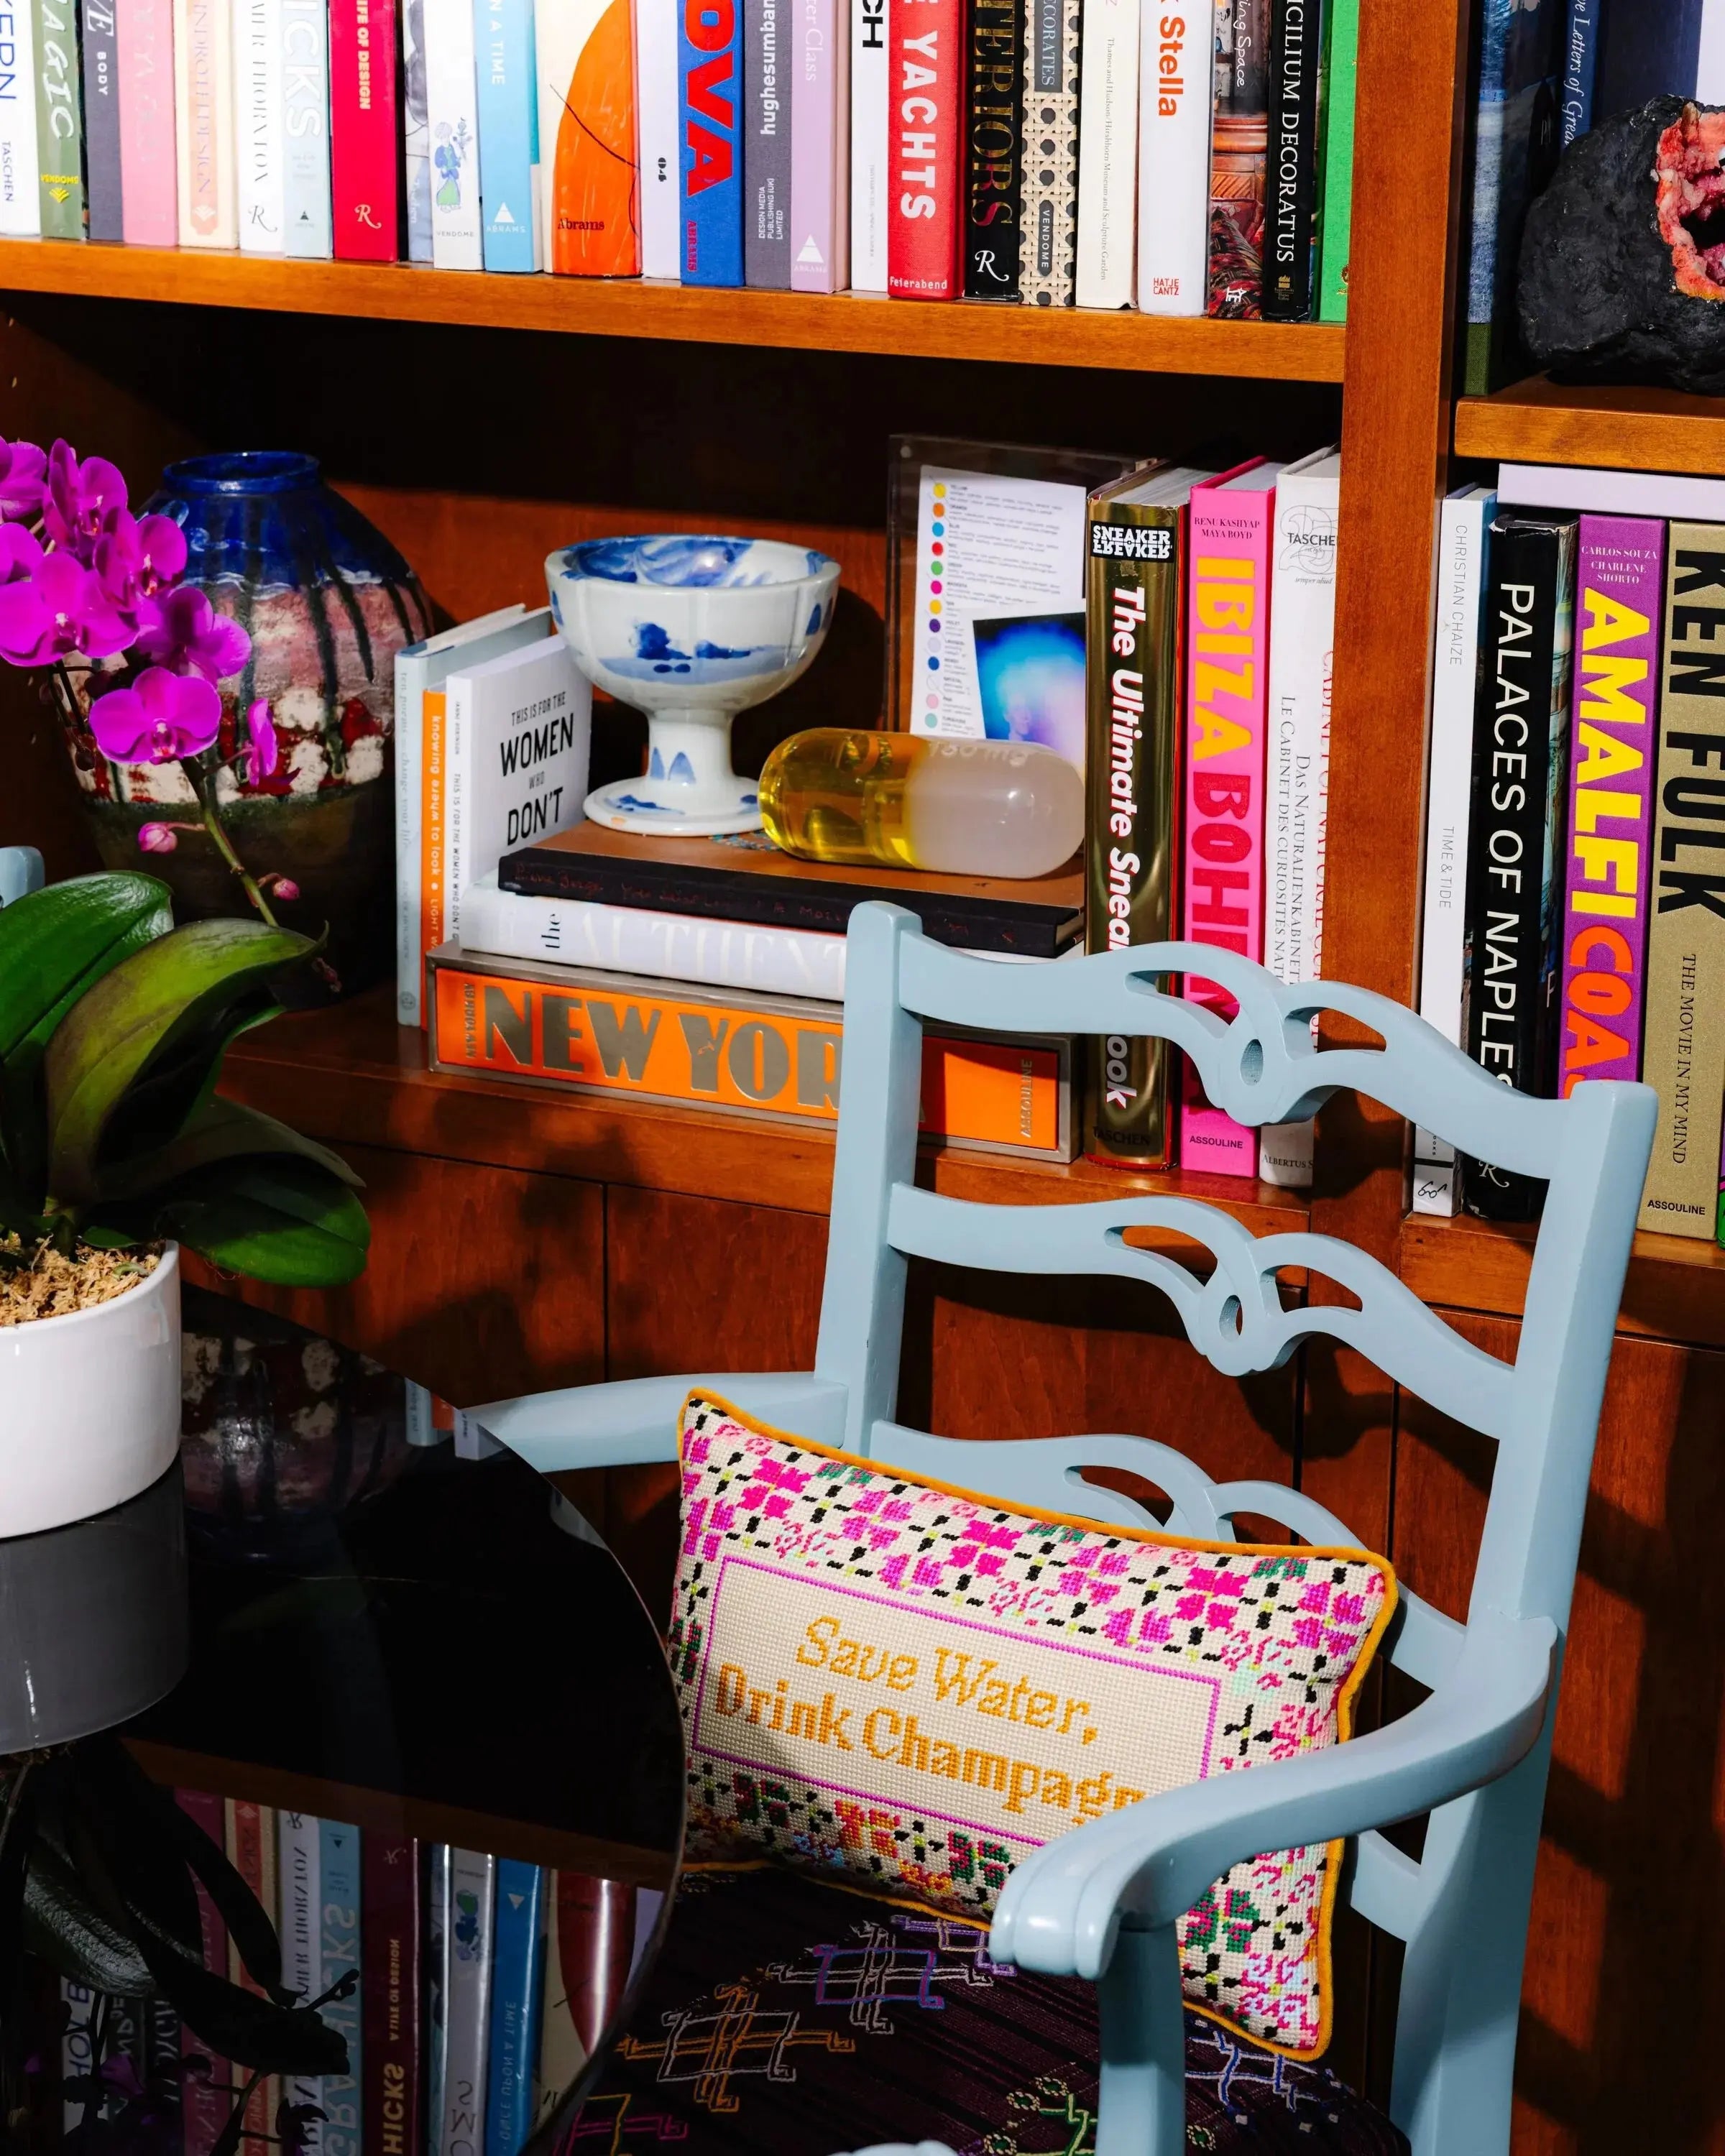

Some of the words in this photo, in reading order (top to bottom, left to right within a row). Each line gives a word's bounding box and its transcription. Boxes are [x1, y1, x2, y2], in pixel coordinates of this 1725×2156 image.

[357, 27, 370, 48] OF
[806, 28, 824, 81] Class
[1106, 37, 1116, 68] Thames
[1570, 15, 1591, 73] Letters
[42, 0, 74, 139] AGIC
[96, 51, 109, 96] BODY
[358, 50, 372, 110] DESIGN
[491, 40, 505, 85] TIME
[1159, 16, 1185, 117] Stella
[1235, 35, 1252, 88] Space
[1564, 77, 1584, 97] of
[253, 60, 270, 184] THORNTON
[900, 30, 937, 219] YACHTS
[1, 141, 14, 203] TASCHEN
[40, 173, 78, 185] VENDOME
[1103, 162, 1111, 195] Museum
[1276, 111, 1300, 262] DECORATUS
[557, 217, 605, 231] Abrams
[1041, 209, 1052, 269] VENDOME
[1100, 212, 1110, 251] Sculpture
[686, 218, 698, 272] ABRAMS
[889, 275, 948, 290] Feierabend
[1100, 250, 1110, 281] Garden
[1153, 277, 1179, 287] HATJE
[1153, 286, 1179, 296] CANTZ
[1092, 525, 1171, 545] SNEAKER
[1194, 517, 1218, 528] RENU
[1220, 518, 1260, 529] KASHYAP
[1201, 529, 1225, 540] MAYA
[1226, 530, 1253, 540] BOYD
[1288, 532, 1336, 547] TASCHE
[1453, 525, 1468, 606] CHRISTIAN
[1581, 546, 1622, 558] CARLOS
[1623, 549, 1657, 559] SOUZA
[1591, 561, 1647, 573] CHARLENE
[1596, 573, 1639, 585] SHORTO
[1112, 586, 1146, 656] The
[1450, 612, 1464, 665] CHAIZE
[1668, 549, 1725, 698] KEN
[1193, 557, 1256, 762] IBIZA
[511, 707, 529, 727] THIS
[530, 705, 537, 719] IS
[538, 697, 551, 715] FOR
[552, 691, 566, 709] THE
[1281, 695, 1296, 715] LE
[1491, 584, 1536, 812] PALACES
[430, 714, 443, 775] knowing
[500, 712, 575, 777] WOMEN
[1110, 669, 1146, 839] Ultimate
[1278, 720, 1296, 799] CABINET
[1571, 587, 1651, 918] AMALFI
[453, 773, 461, 793] THIS
[528, 771, 546, 791] WHO
[1295, 755, 1310, 788] DAS
[431, 779, 441, 821] where
[453, 796, 461, 806] IS
[507, 787, 564, 847] DON'T
[1278, 803, 1289, 833] DES
[431, 826, 440, 842] to
[1441, 826, 1455, 860] TIME
[1657, 730, 1725, 920] FULK
[431, 846, 441, 877] look
[1440, 864, 1453, 875] &
[1488, 830, 1525, 894] OF
[1275, 836, 1290, 935] CURIOSITÉS
[1439, 877, 1452, 909] TIDE
[430, 898, 440, 931] LIGHT
[540, 913, 561, 949] the
[1682, 954, 1696, 992] THE
[464, 1000, 476, 1031] YORK
[1564, 925, 1634, 1100] COA
[1678, 997, 1694, 1054] MOVIE
[465, 1033, 476, 1059] NEW
[484, 985, 661, 1083] NEW
[678, 1011, 844, 1110] YOR
[1107, 1036, 1137, 1109] ook
[1678, 1059, 1691, 1077] IN
[1020, 1058, 1033, 1138] ASSOULINE
[1675, 1083, 1690, 1111] MY
[1092, 1126, 1151, 1146] TASCHEN
[1189, 1135, 1243, 1149] ASSOULINE
[1673, 1115, 1689, 1164] MIND
[1261, 1153, 1305, 1169] ALBERTUS
[1647, 1199, 1706, 1216] ASSOULINE
[796, 1615, 920, 1692] Save
[934, 1646, 1099, 1746] Water,
[714, 1662, 855, 1752] Drink
